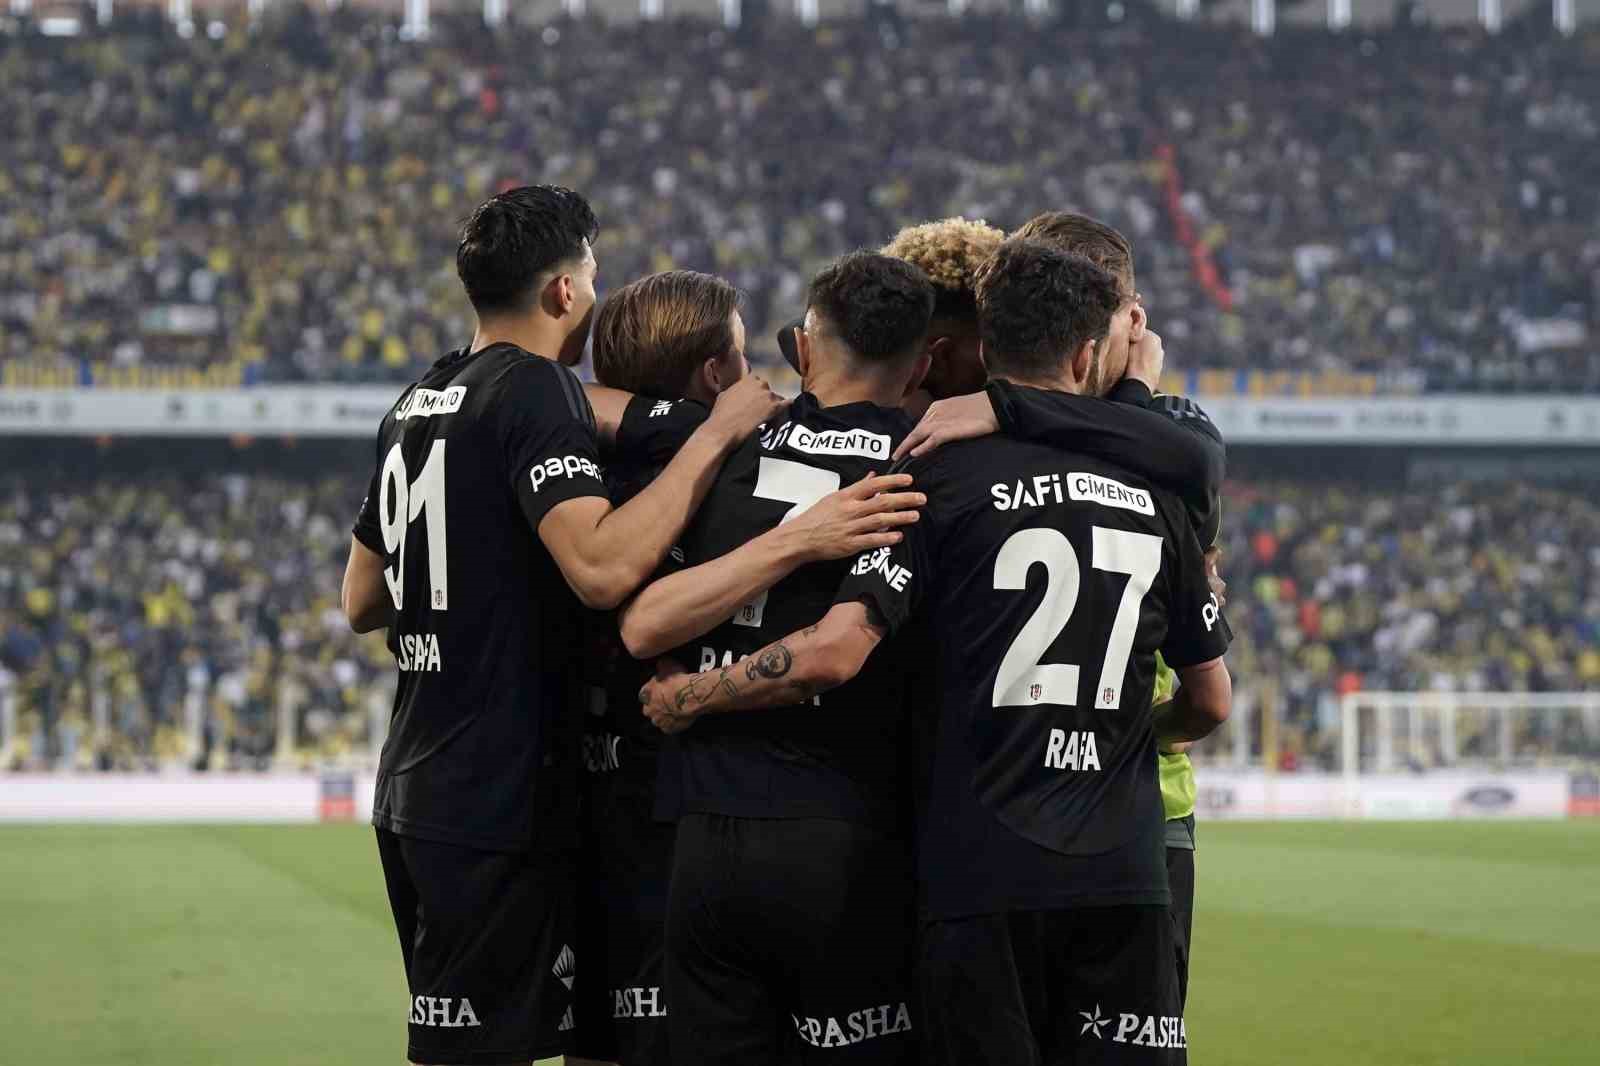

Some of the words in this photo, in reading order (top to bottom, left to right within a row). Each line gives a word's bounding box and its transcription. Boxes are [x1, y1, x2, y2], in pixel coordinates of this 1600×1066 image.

[529, 455, 603, 493] papar
[1076, 474, 1147, 508] ÇİMENTO
[380, 438, 447, 611] 91
[992, 525, 1164, 710] 27
[806, 1002, 912, 1047] PASHA
